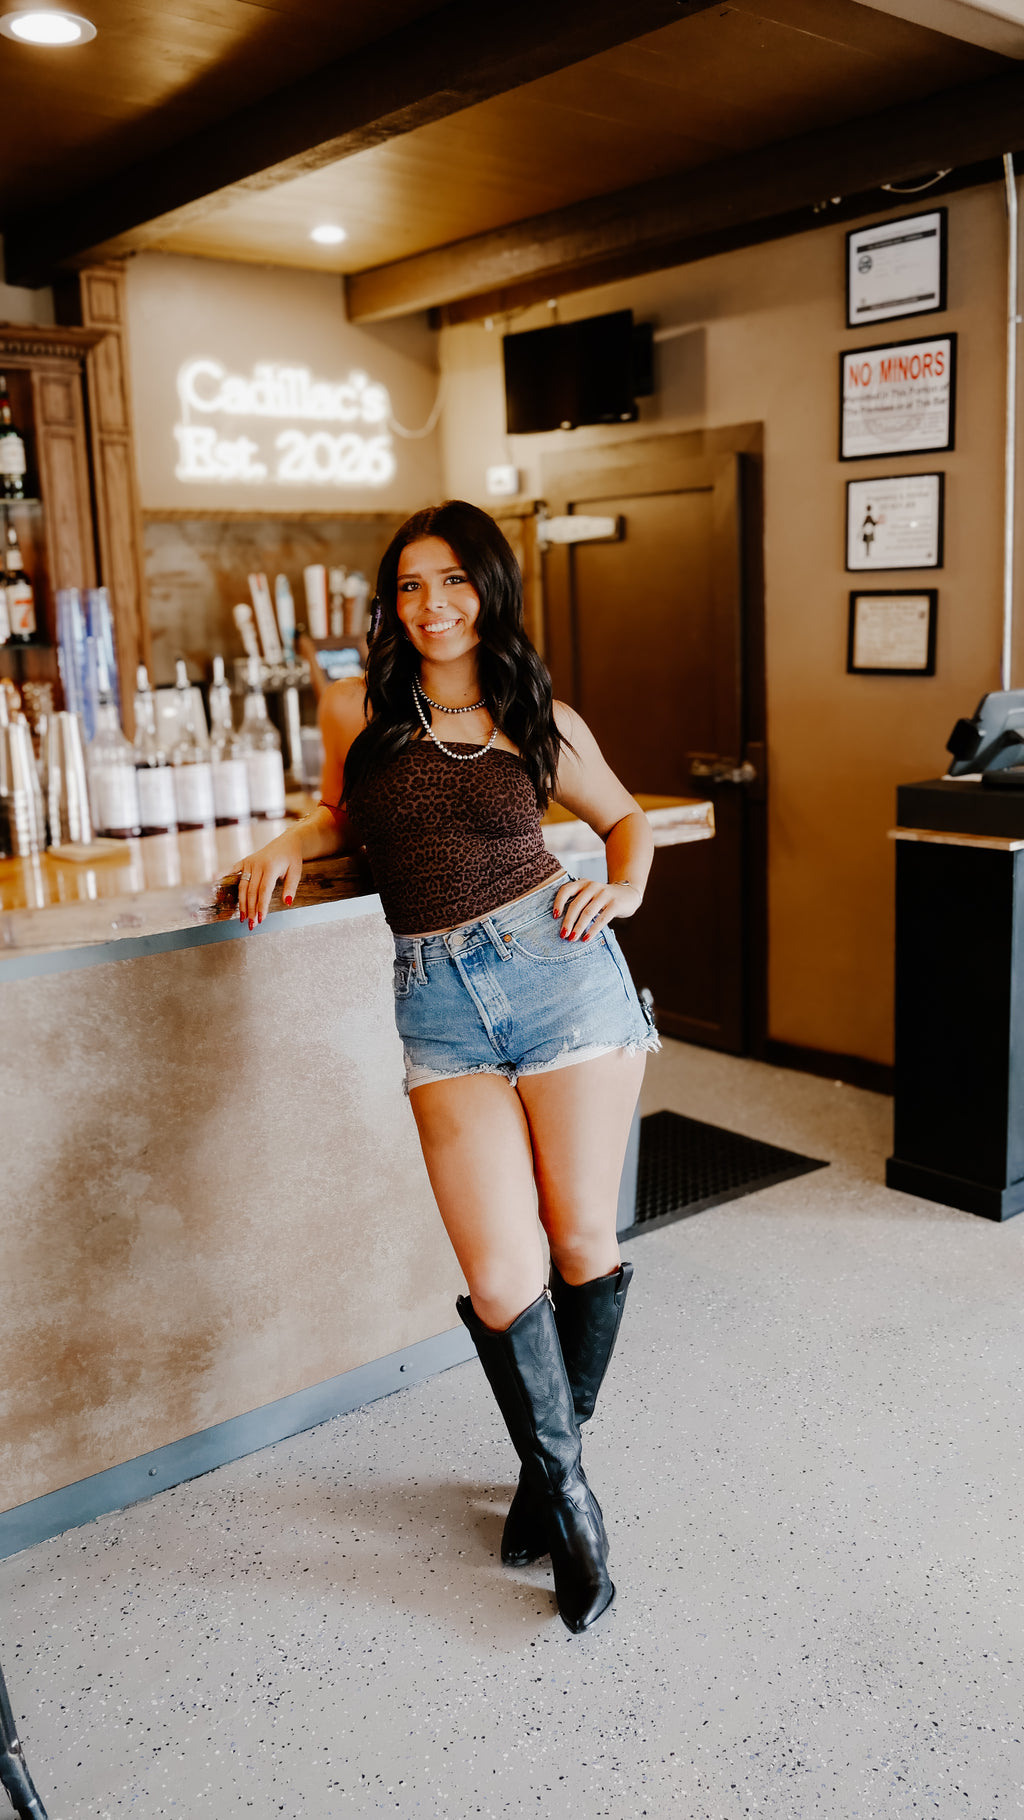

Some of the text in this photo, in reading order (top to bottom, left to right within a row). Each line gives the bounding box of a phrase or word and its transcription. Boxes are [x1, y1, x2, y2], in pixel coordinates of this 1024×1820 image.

[177, 358, 391, 424] Cadillac's
[848, 351, 945, 388] NO MINORS
[173, 423, 396, 485] Est. 2026
[14, 599, 34, 628] 7
